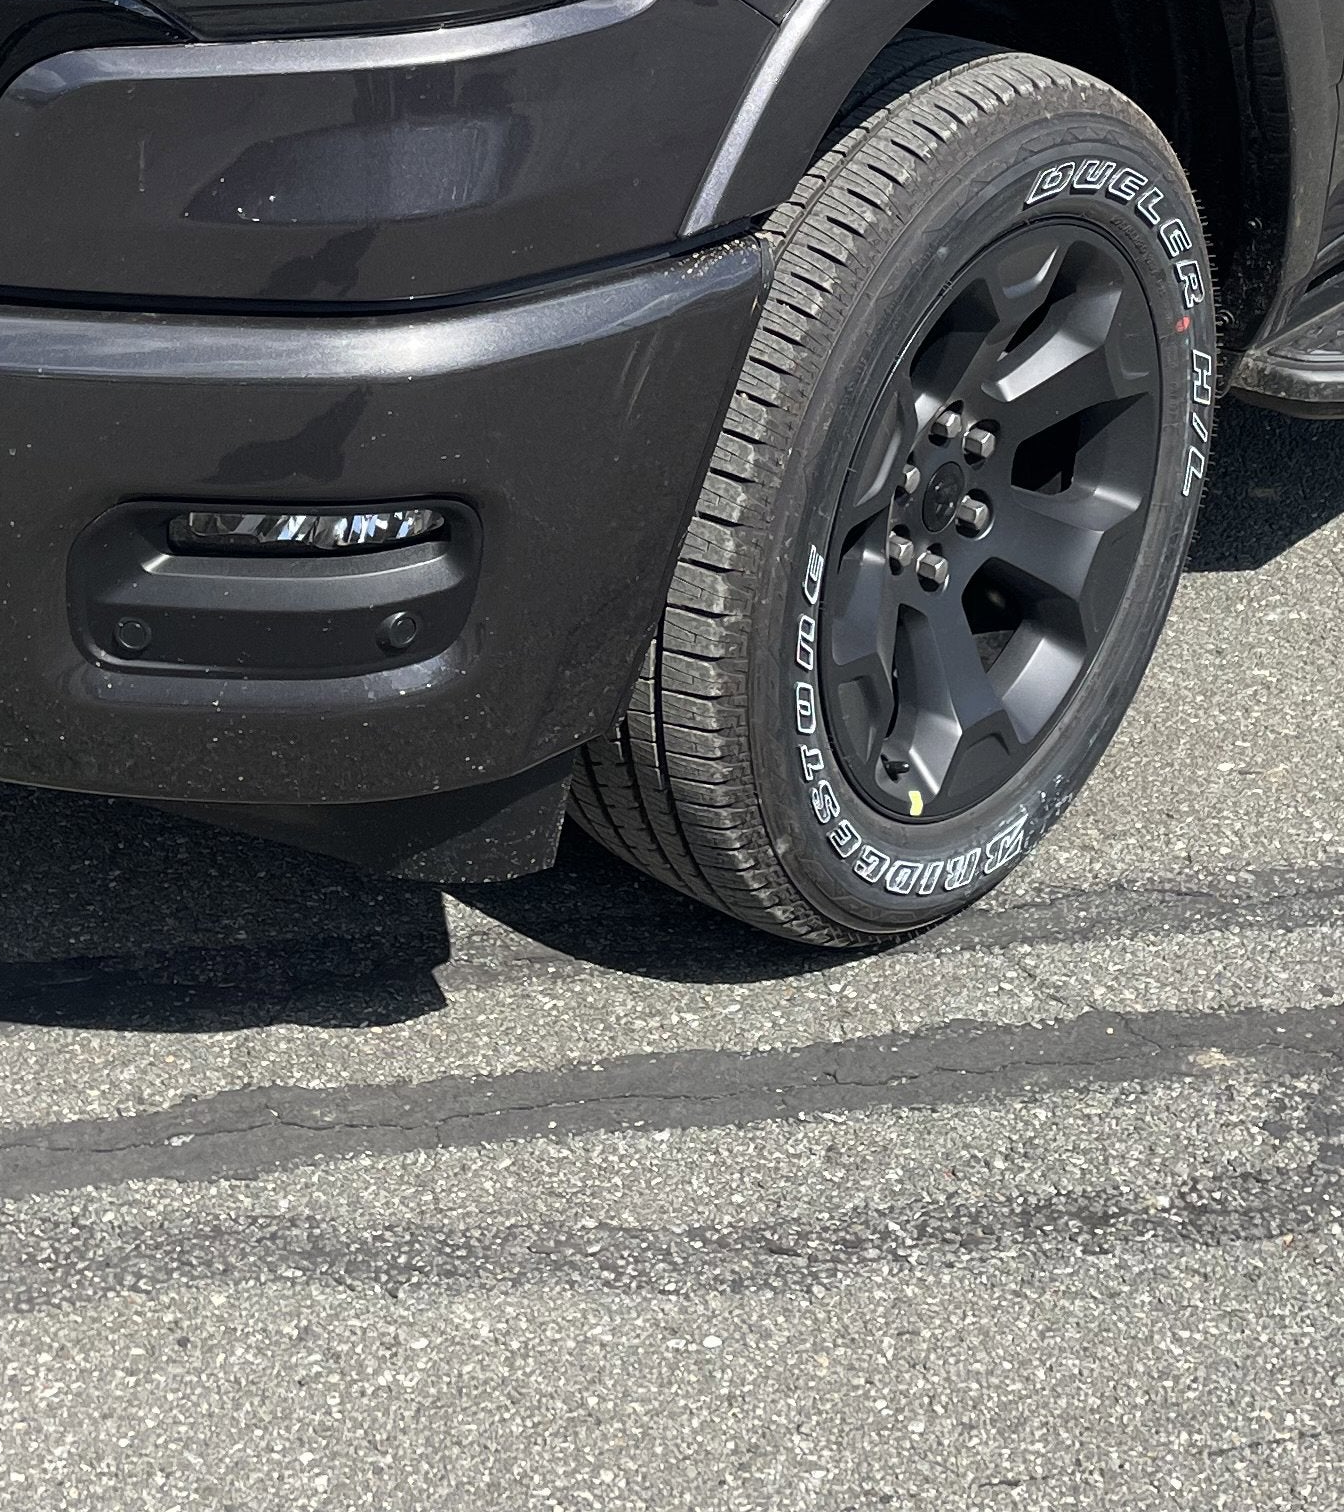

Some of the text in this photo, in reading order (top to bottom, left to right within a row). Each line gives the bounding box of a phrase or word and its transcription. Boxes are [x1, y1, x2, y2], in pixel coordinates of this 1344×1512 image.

[1025, 159, 1205, 309] DUELER
[1182, 349, 1212, 497] H/L
[795, 544, 1030, 896] BRIDGESTONE
